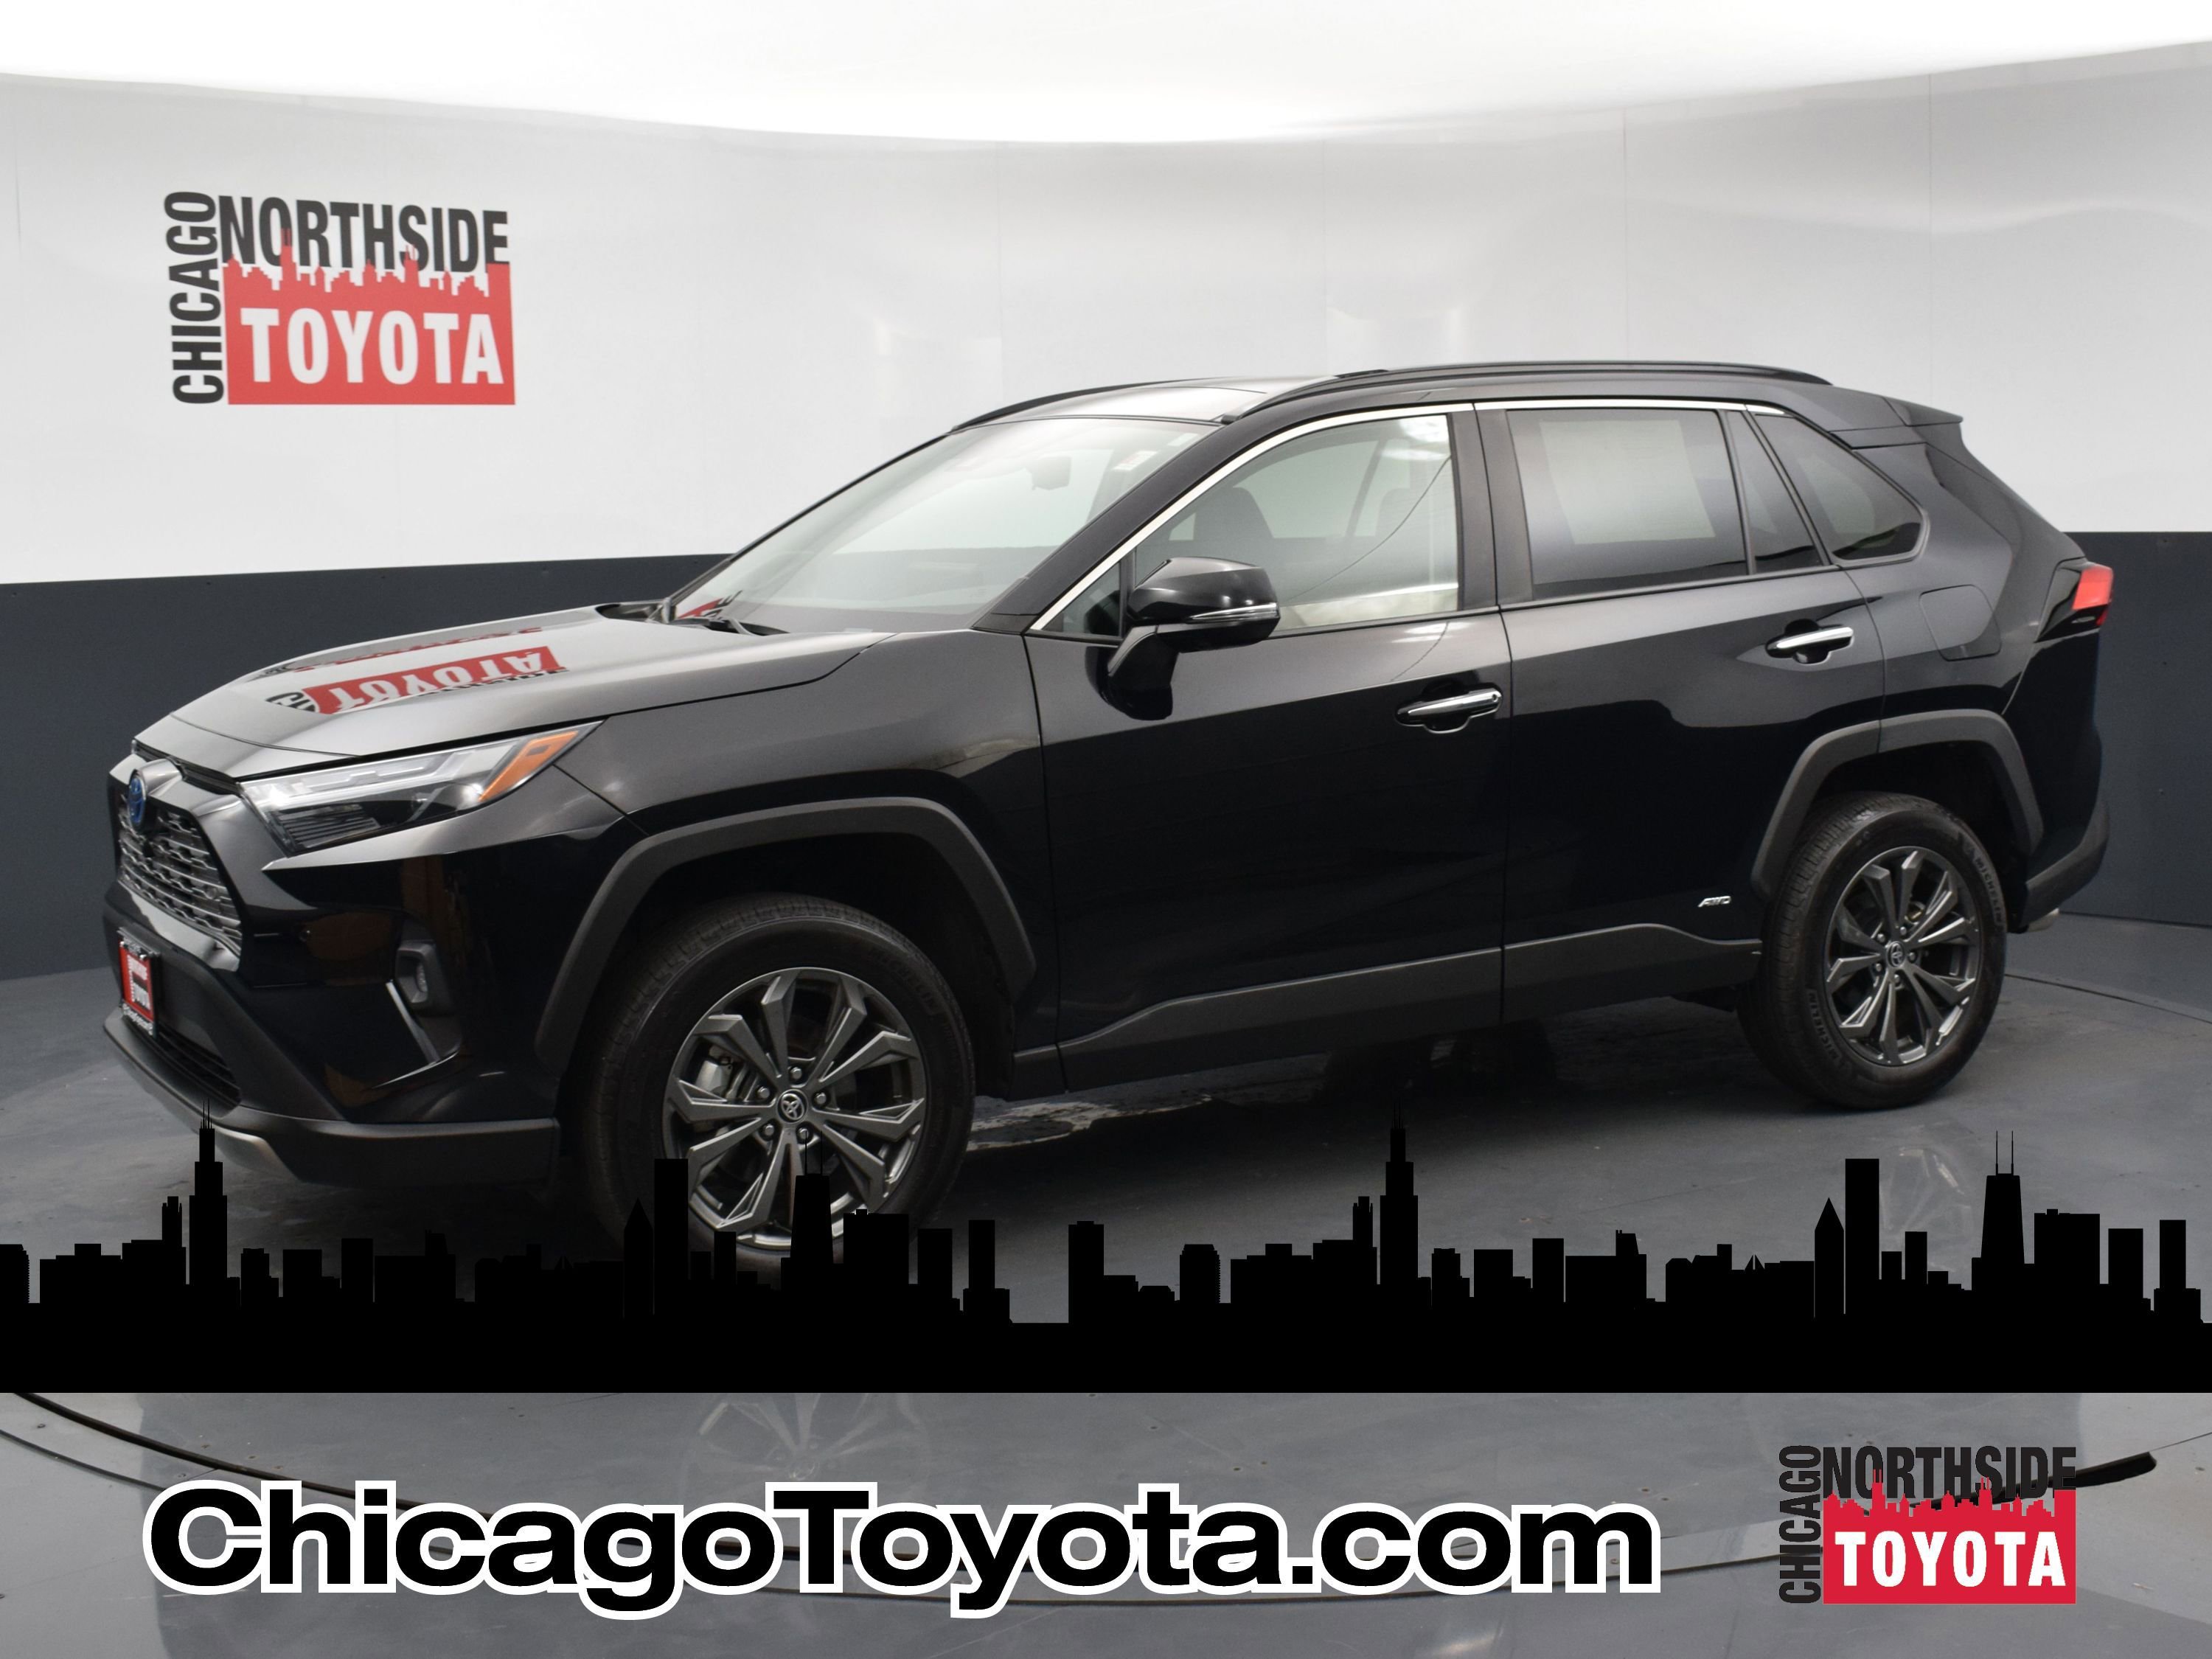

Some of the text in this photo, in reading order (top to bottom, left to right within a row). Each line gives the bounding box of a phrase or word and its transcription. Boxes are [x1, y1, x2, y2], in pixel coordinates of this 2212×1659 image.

[218, 195, 509, 273] NORTHSIDE
[164, 191, 224, 404] CHICAGO
[240, 307, 504, 385] TOYOTA
